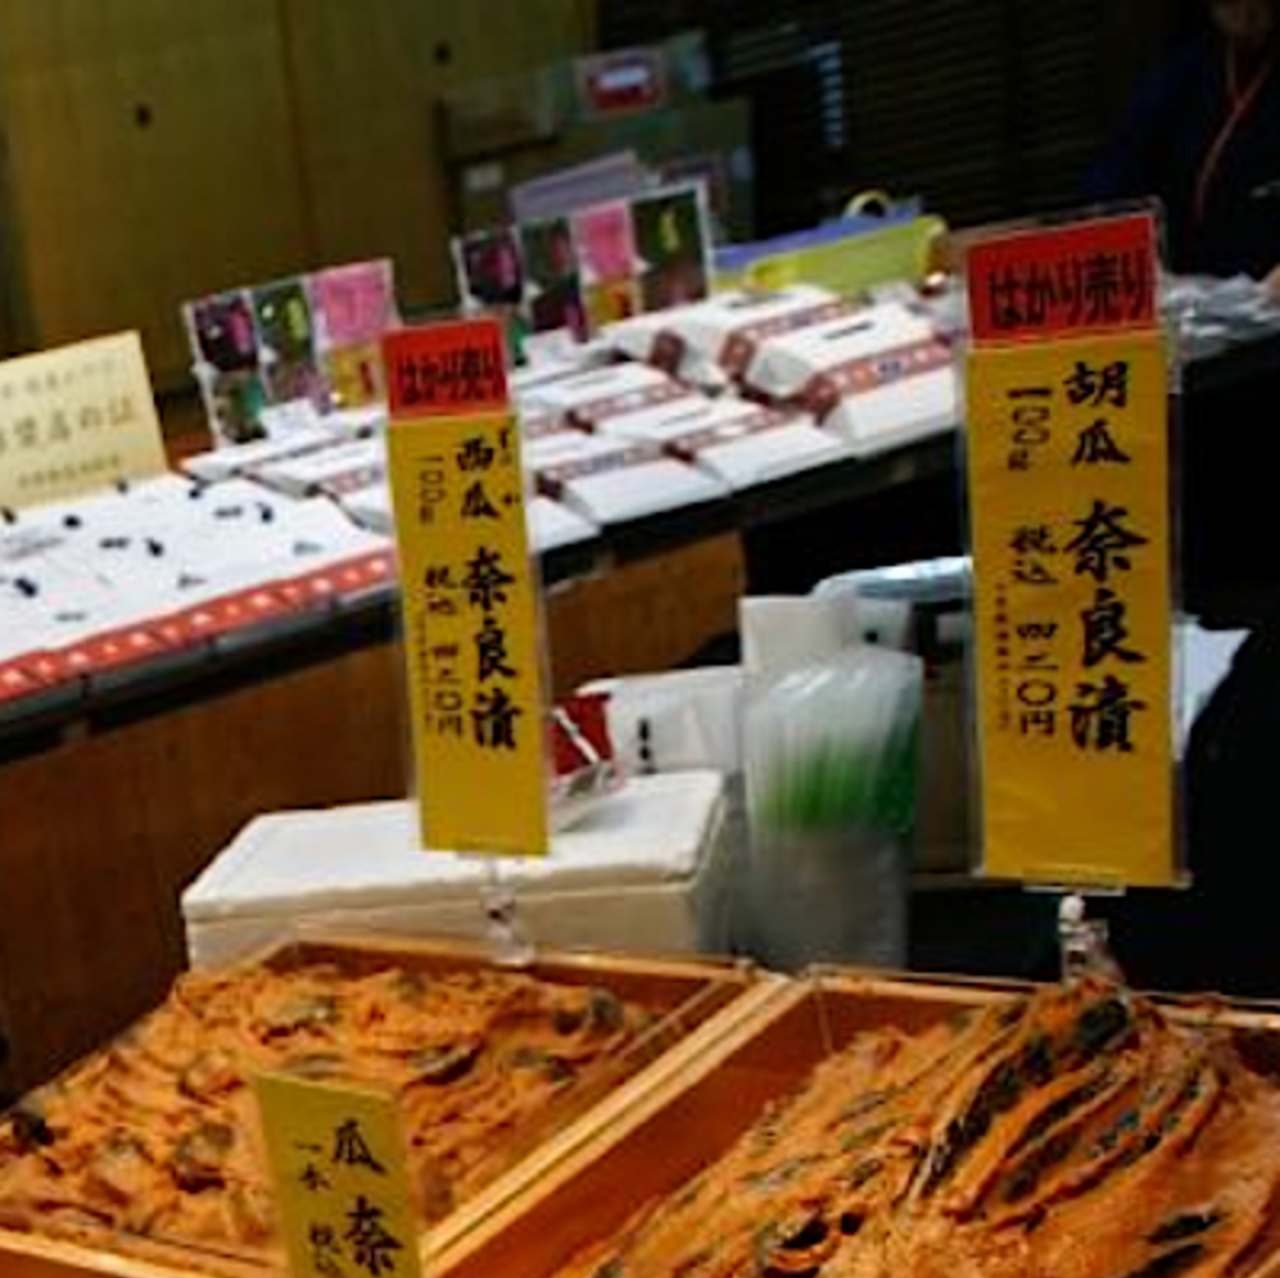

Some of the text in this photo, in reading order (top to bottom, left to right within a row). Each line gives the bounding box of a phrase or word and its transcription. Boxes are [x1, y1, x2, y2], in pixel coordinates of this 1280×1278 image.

[989, 251, 1154, 327] はかり売り
[1063, 360, 1150, 755] 胡瓜 奈良漬
[461, 545, 524, 752] 奈良漬
[332, 1118, 385, 1175] 瓜
